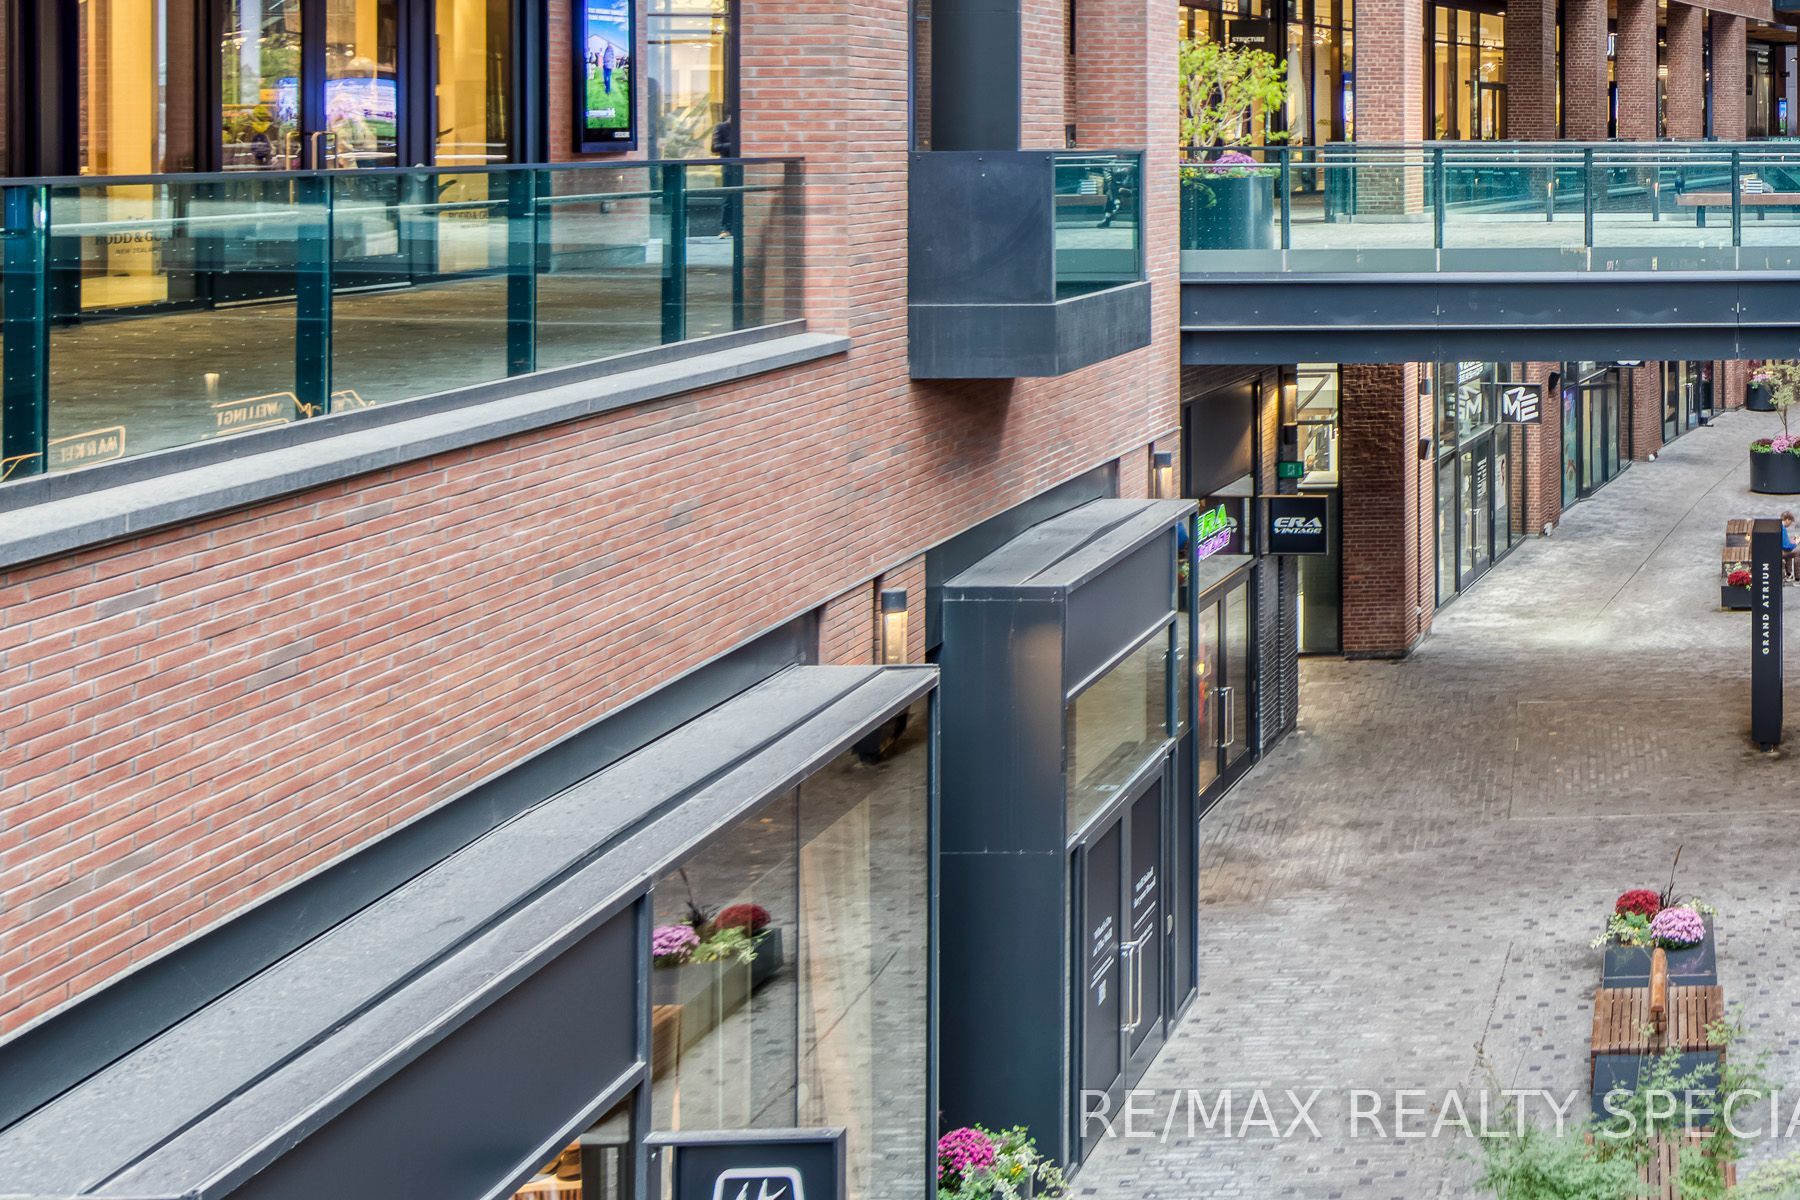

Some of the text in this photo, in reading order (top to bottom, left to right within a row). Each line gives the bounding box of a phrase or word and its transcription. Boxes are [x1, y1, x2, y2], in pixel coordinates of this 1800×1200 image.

[1273, 516, 1323, 528] ERA
[1273, 527, 1323, 535] VINTAGE
[1762, 563, 1770, 655] GRAND ATRIUM
